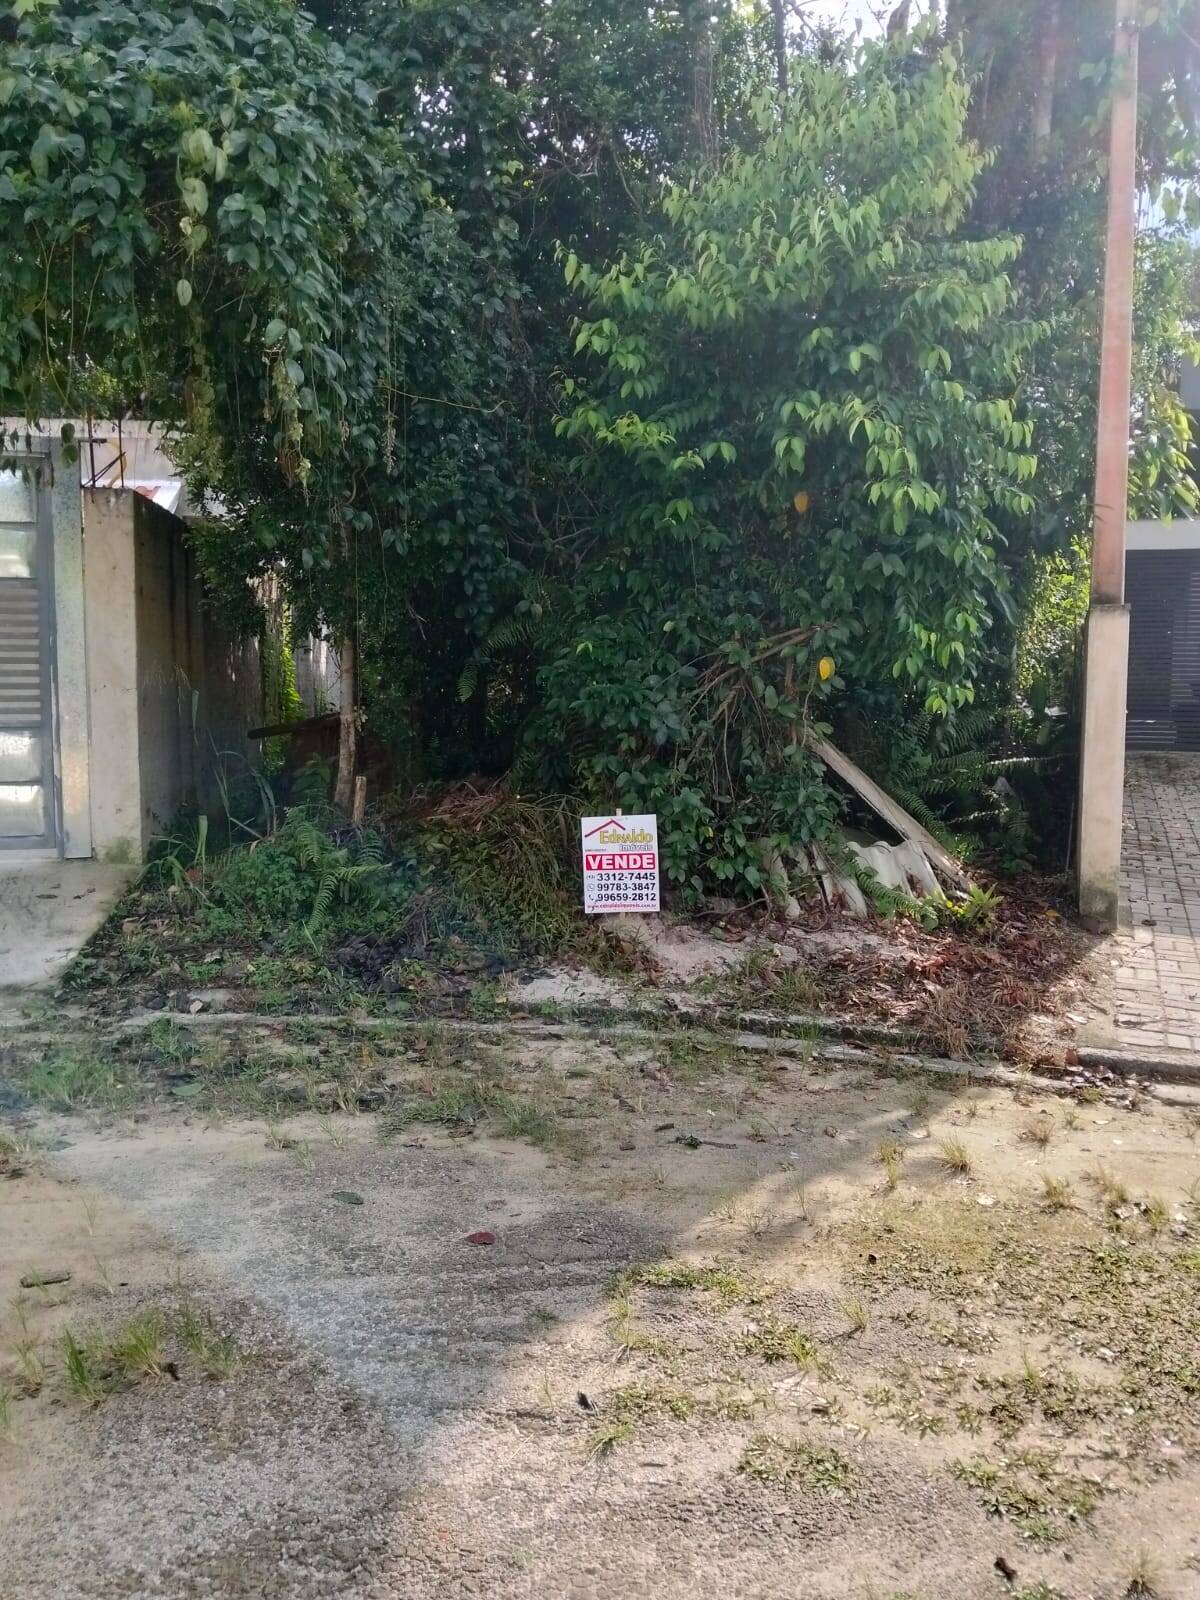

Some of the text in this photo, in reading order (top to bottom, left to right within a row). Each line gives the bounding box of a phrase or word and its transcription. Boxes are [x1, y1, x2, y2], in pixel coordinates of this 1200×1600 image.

[587, 855, 654, 869] VENDE
[597, 873, 656, 881] 3312-7445
[597, 883, 656, 891] 99783-3847
[597, 893, 656, 901] 99659-2812
